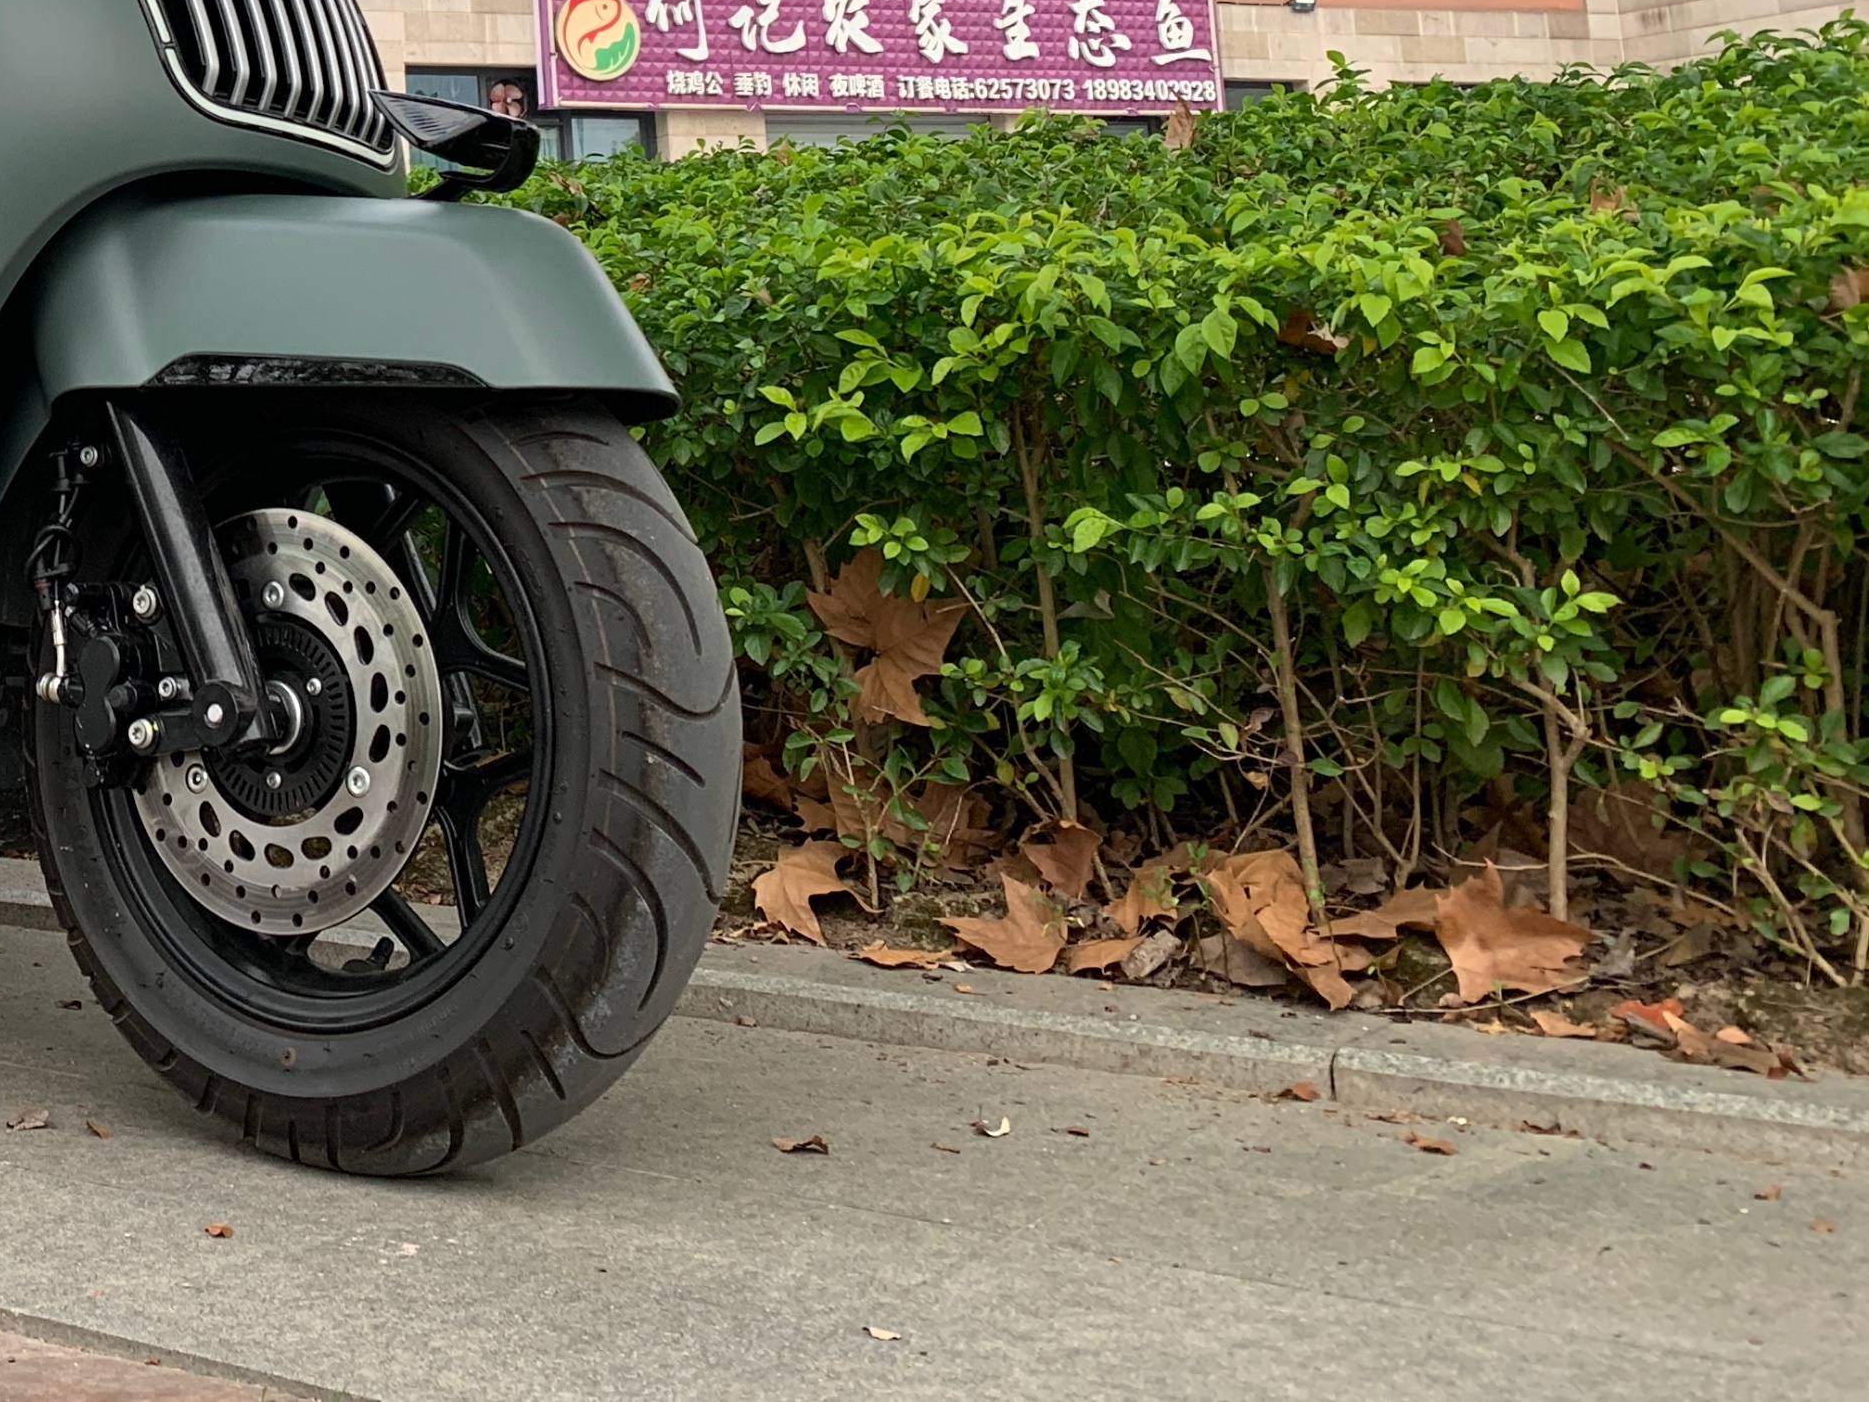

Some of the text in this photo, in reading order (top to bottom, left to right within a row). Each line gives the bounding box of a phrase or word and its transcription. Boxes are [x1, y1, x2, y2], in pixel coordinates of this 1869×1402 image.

[667, 70, 724, 96] 烧鸡公
[783, 73, 820, 97] 休闲
[829, 74, 885, 98] 夜啤酒
[1084, 79, 1217, 102] 18983402928
